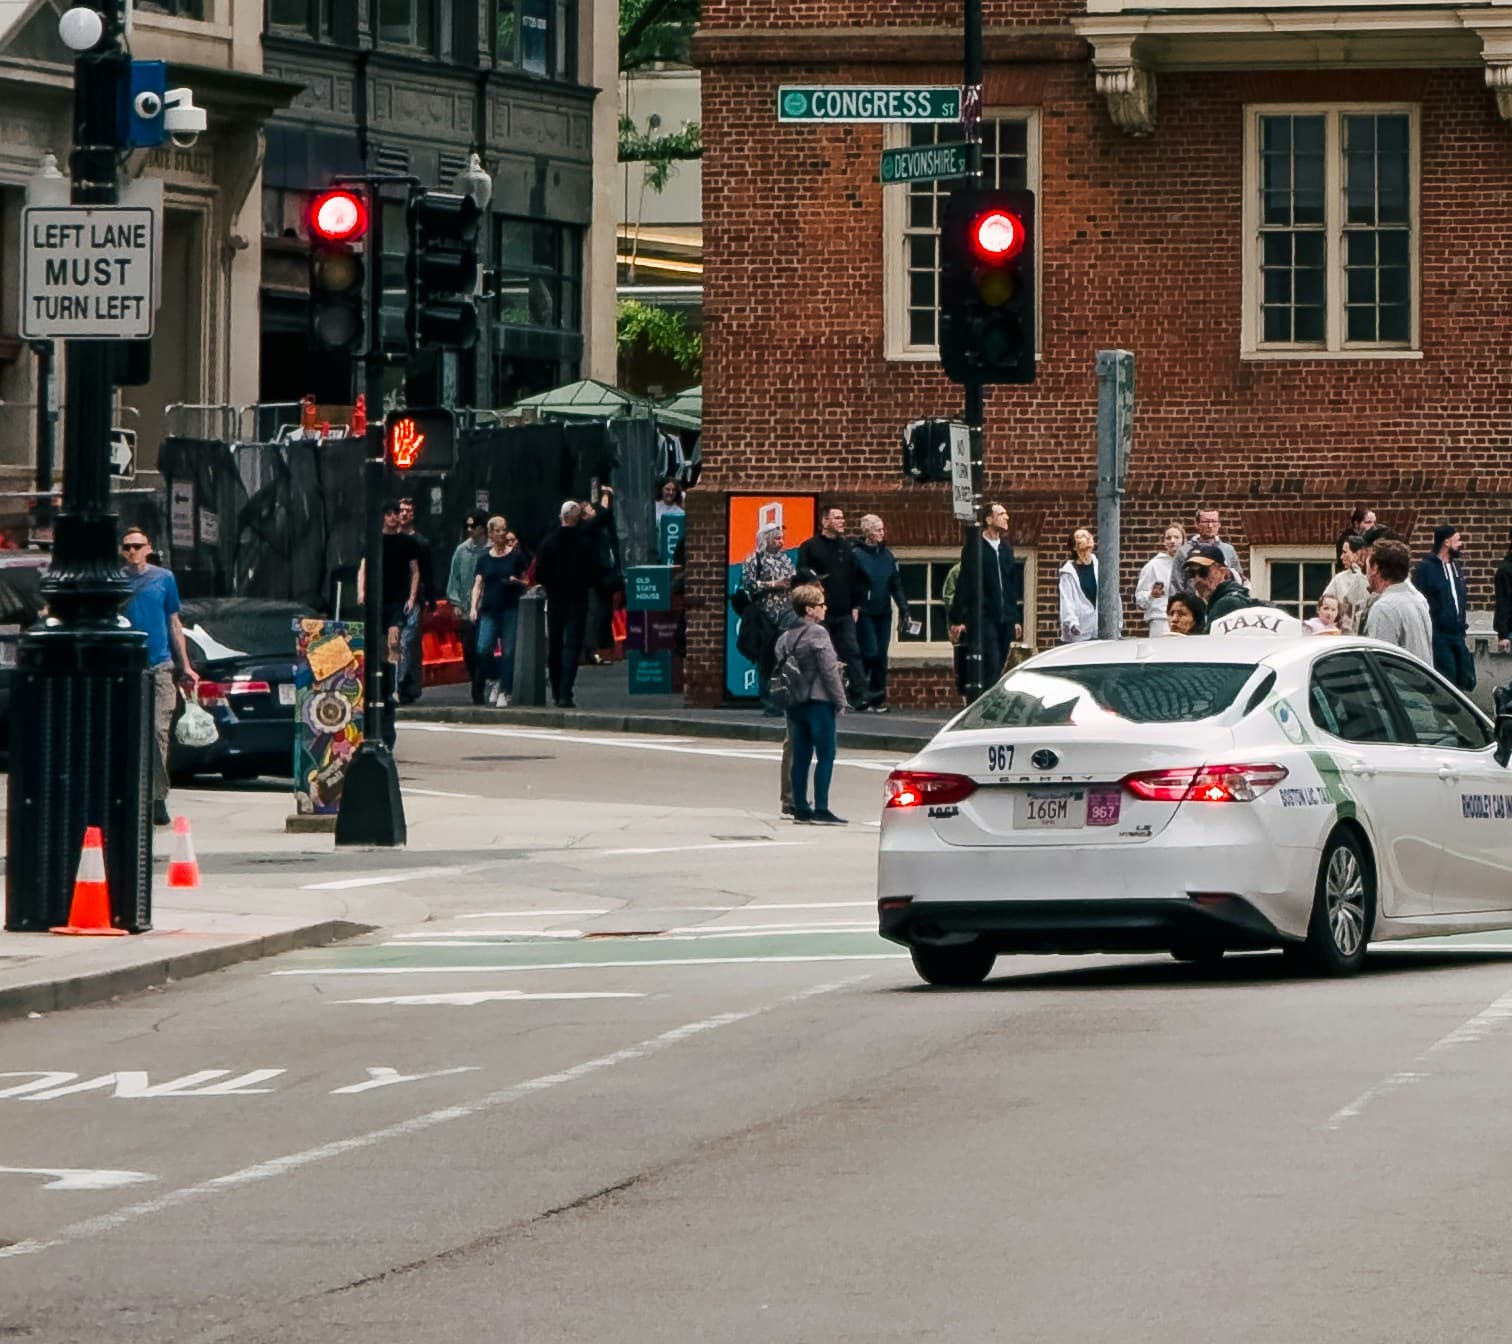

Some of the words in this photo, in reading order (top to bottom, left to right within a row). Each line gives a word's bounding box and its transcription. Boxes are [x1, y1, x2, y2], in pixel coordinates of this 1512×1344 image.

[811, 91, 932, 117] CONGRESS
[941, 102, 955, 117] ST
[893, 148, 957, 178] DEVONSHIRE
[33, 224, 85, 249] LEFT
[91, 224, 147, 249] LANE
[45, 258, 132, 286] MUST
[32, 295, 89, 320] TURN
[95, 295, 145, 320] LEFT
[1218, 615, 1284, 635] TAXI
[988, 745, 1015, 772] 967
[1027, 800, 1068, 820] 16GM
[1091, 806, 1116, 819] 967
